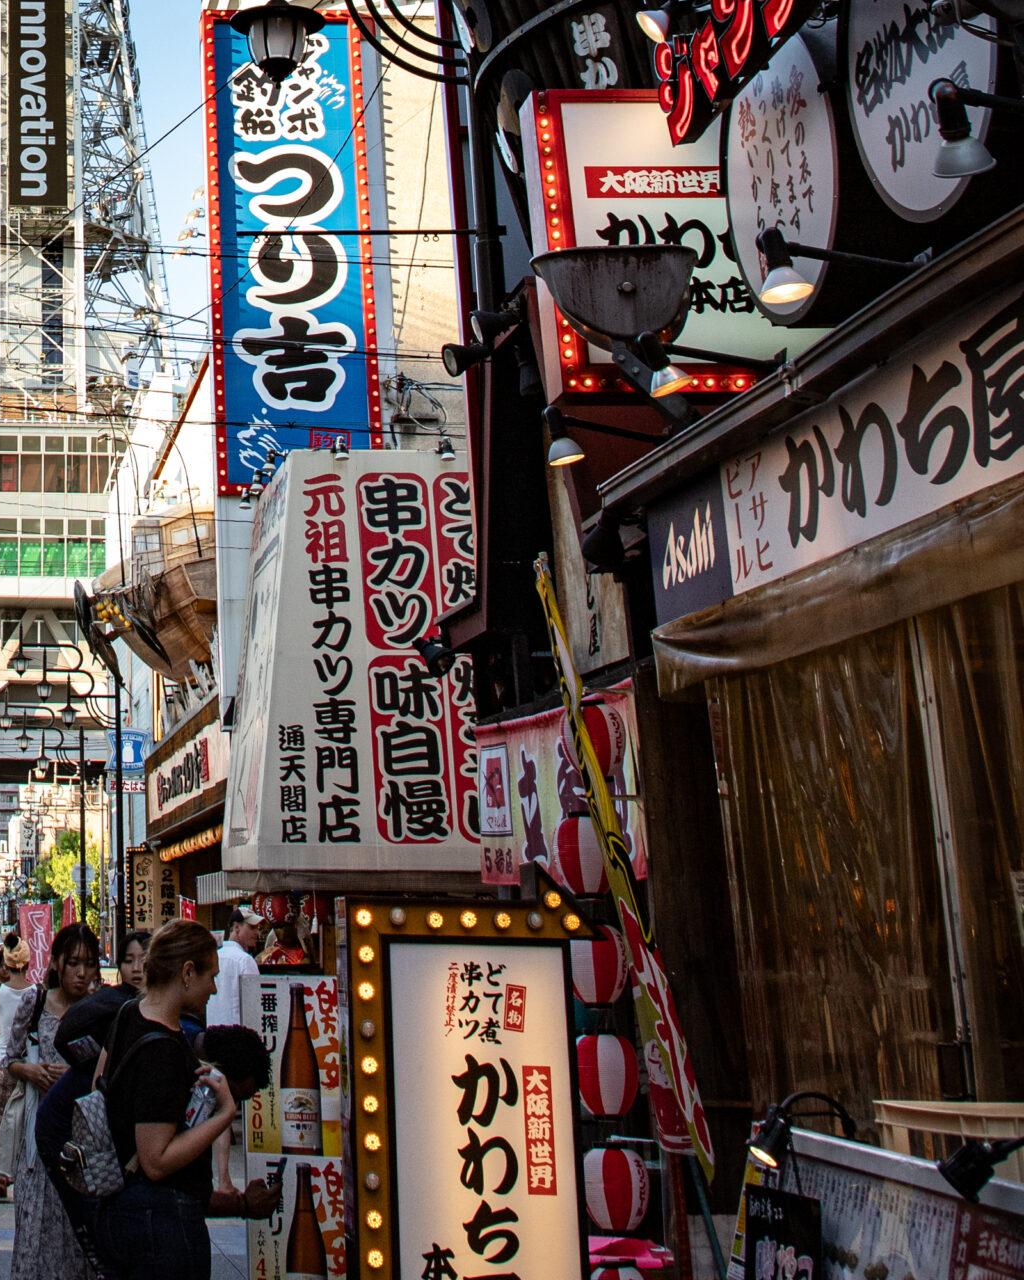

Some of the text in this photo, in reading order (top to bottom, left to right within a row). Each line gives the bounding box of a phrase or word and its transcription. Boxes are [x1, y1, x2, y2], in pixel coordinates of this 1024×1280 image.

[597, 168, 723, 196] 大阪新世界
[232, 150, 350, 405] つり吉
[596, 211, 736, 269] かわ
[687, 276, 756, 314] 本店
[661, 500, 716, 590] Asahi
[725, 456, 755, 585] ビール
[742, 451, 774, 572] アサヒ
[360, 477, 429, 645] 串カツ
[303, 473, 361, 844] 元祖串カツ専門店
[278, 724, 307, 844] 通天閣店
[373, 662, 450, 840] 味自慢
[135, 879, 148, 923] つり吉
[260, 982, 278, 1054] 一番搾り
[458, 960, 484, 1041] 串カツ
[477, 960, 507, 1045] どて煮
[506, 990, 523, 1027] 名物
[251, 1089, 265, 1144] 50円
[524, 1068, 555, 1190] 大阪新世界
[450, 1052, 522, 1280] かわち
